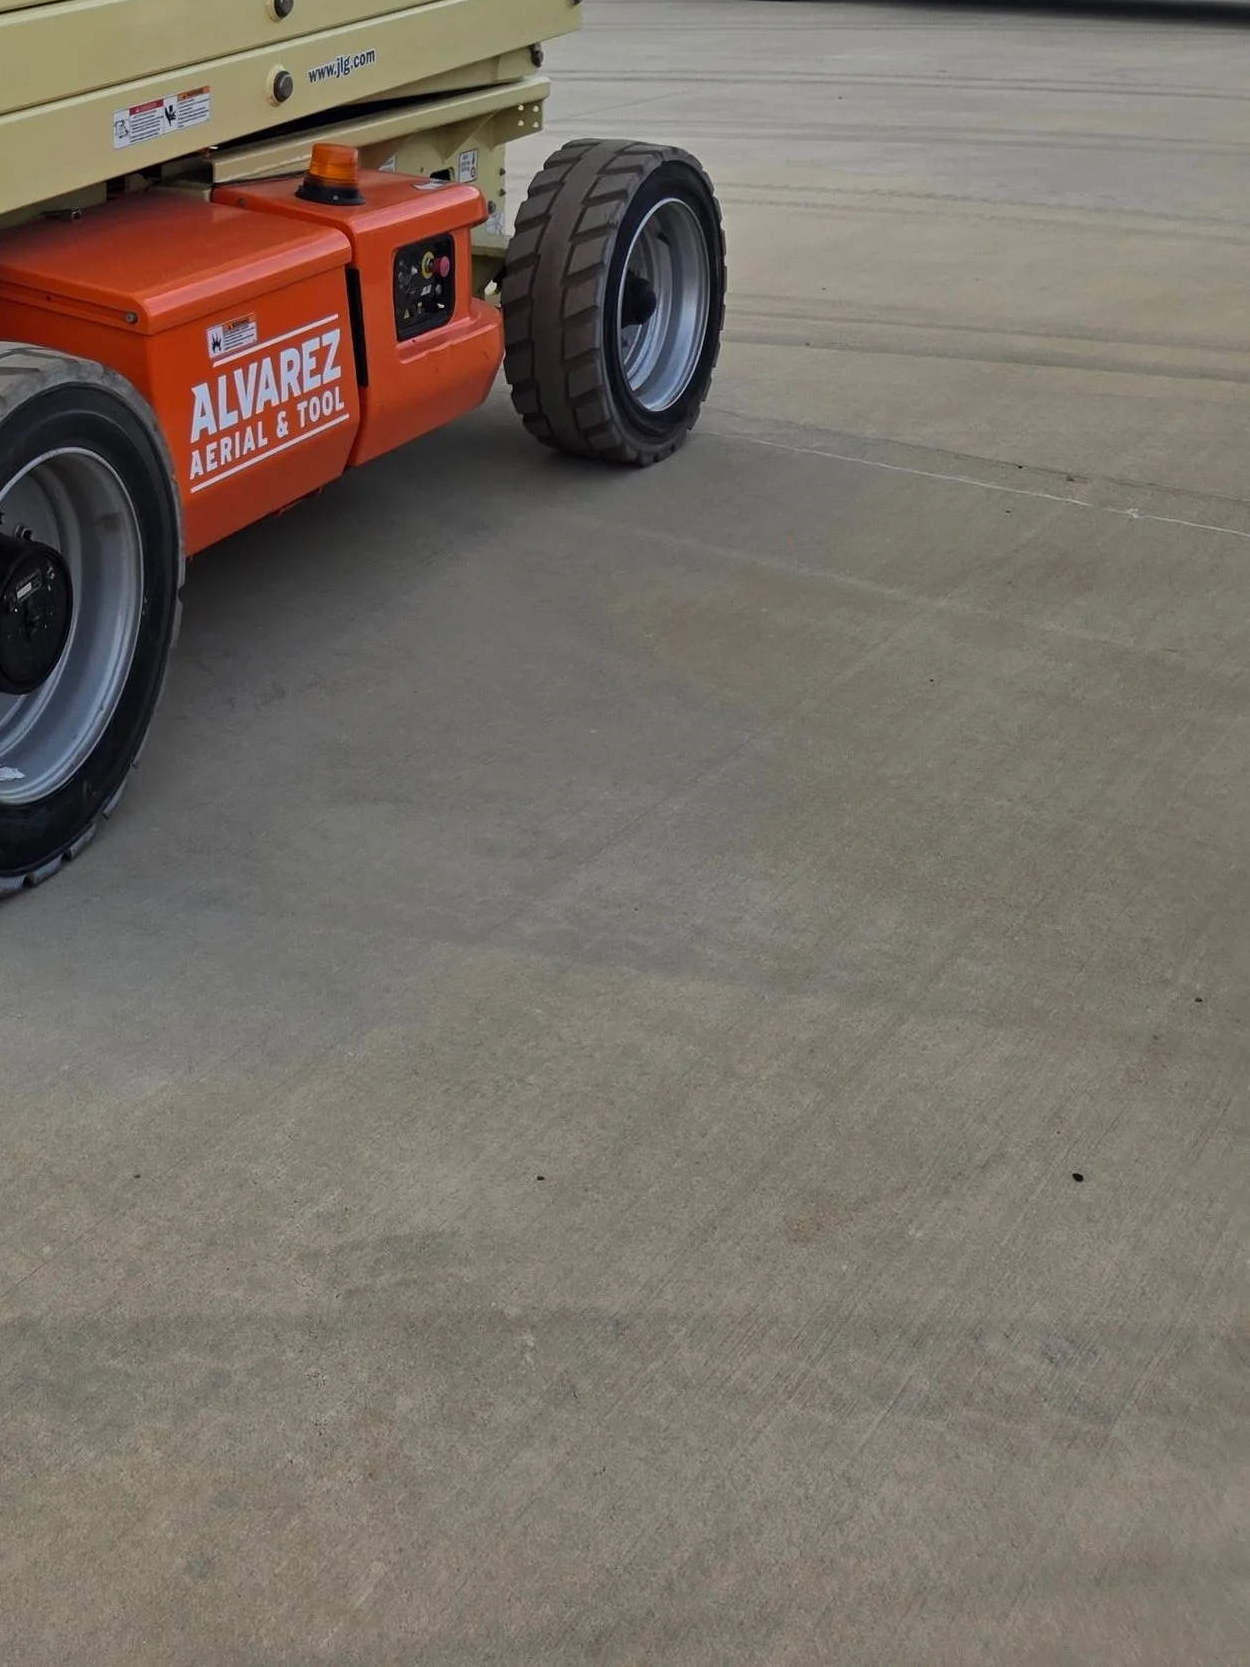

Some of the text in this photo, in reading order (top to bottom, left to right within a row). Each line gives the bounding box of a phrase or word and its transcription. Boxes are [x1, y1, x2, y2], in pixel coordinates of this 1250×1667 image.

[308, 50, 375, 83] www.jlg.com
[190, 328, 342, 444] ALVAREZ
[190, 386, 345, 481] AERIAL & TOOL
